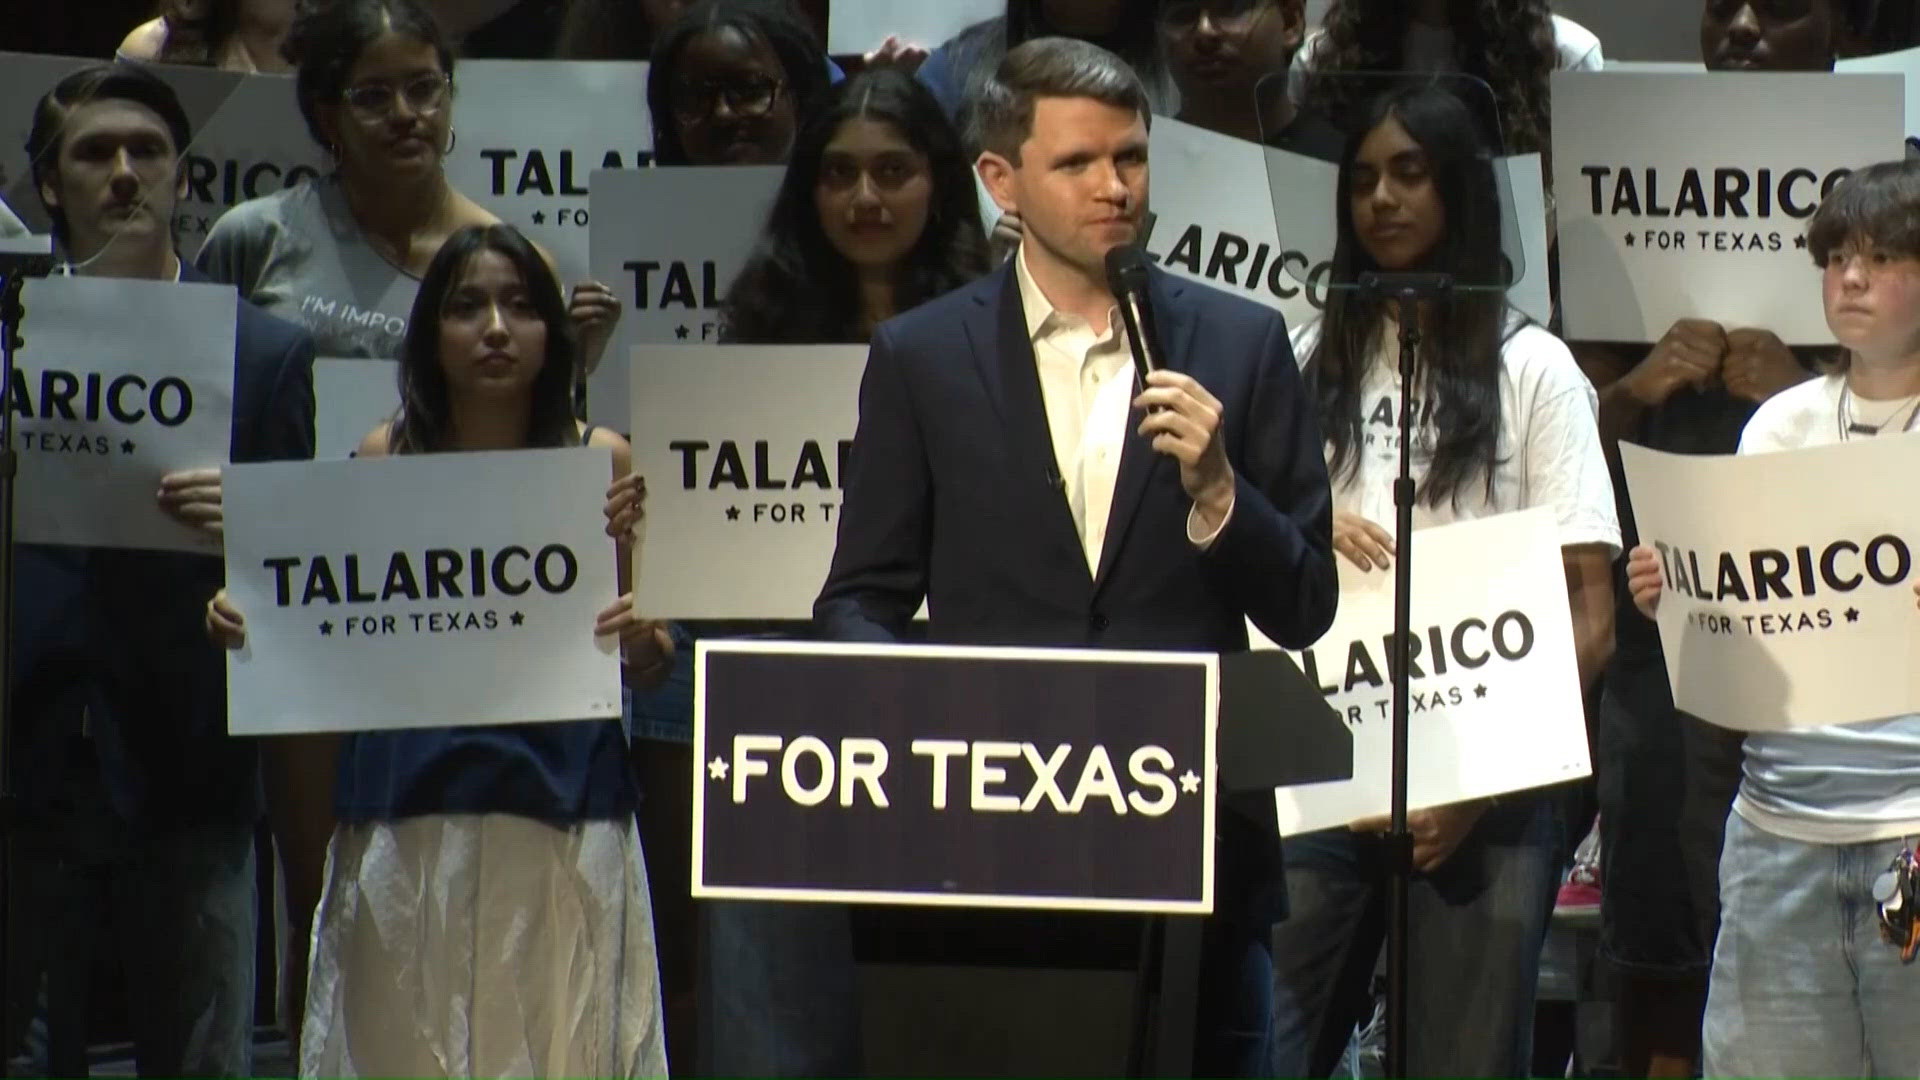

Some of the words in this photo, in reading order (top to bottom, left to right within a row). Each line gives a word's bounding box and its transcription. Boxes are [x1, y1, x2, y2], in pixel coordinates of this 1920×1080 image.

[1645, 231, 1685, 250] FOR
[1698, 231, 1782, 251] TEXAS
[302, 295, 336, 316] I'M
[341, 304, 409, 338] IMPO
[20, 431, 110, 455] TEXAS
[753, 503, 806, 523] FOR
[264, 543, 578, 607] TALARICO
[1655, 534, 1912, 602] TALARICO
[346, 614, 397, 637] FOR
[409, 610, 499, 633] TEXAS
[1699, 612, 1732, 635] FOR
[1742, 608, 1833, 635] TEXAS
[1374, 687, 1463, 719] TXAS
[732, 733, 890, 808] FOR
[911, 740, 1178, 816] TEXAS
